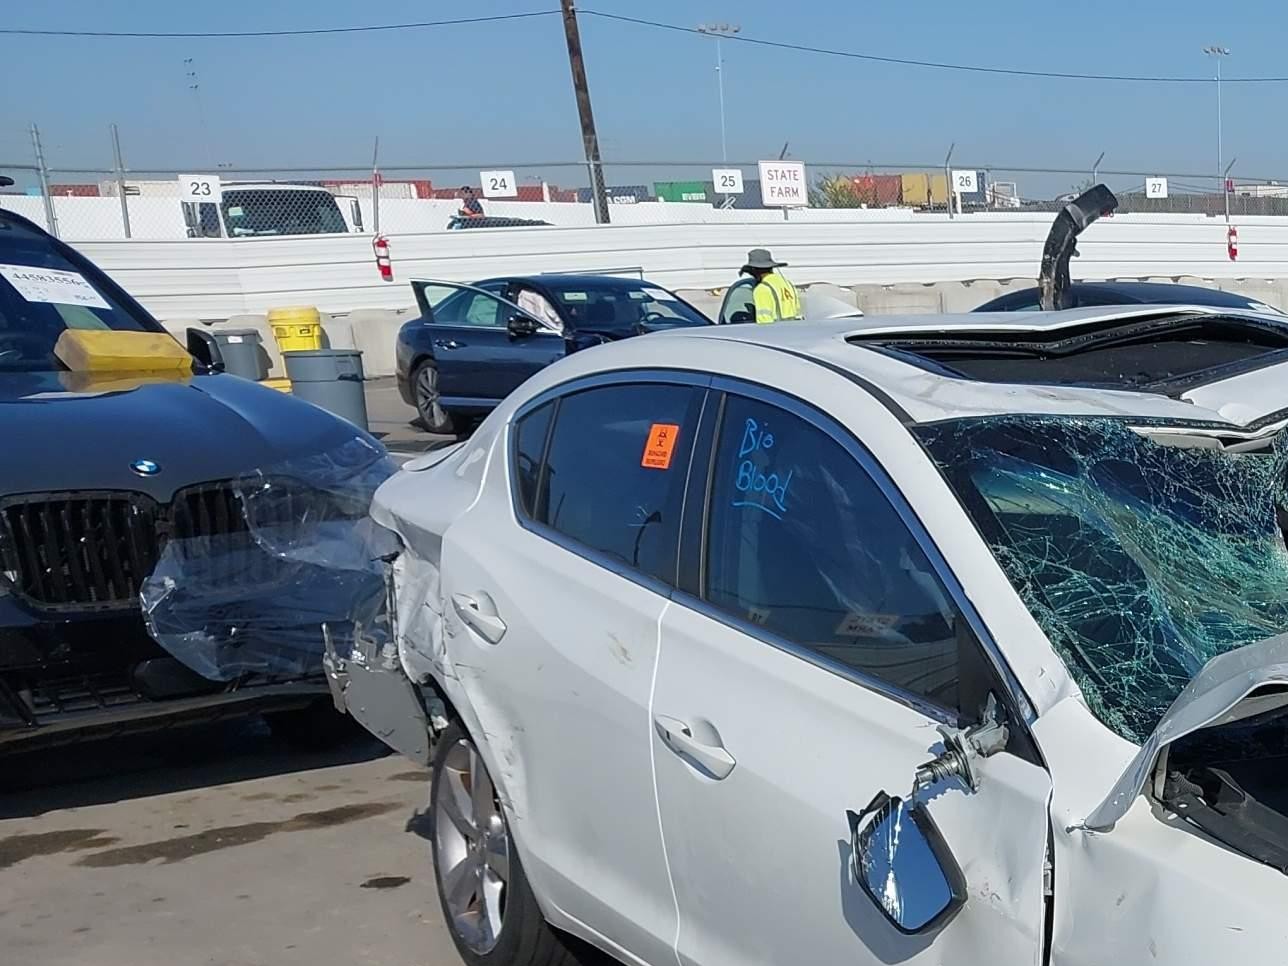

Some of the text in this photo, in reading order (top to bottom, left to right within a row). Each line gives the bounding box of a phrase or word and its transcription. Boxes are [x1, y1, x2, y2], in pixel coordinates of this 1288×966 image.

[720, 175, 736, 187] 25
[767, 169, 799, 181] STATE
[490, 178, 507, 190] 24
[959, 176, 971, 187] 26
[190, 181, 211, 196] 23
[770, 186, 799, 198] FARM
[1151, 183, 1162, 193] 27
[738, 418, 774, 458] Bio
[736, 460, 793, 512] Blood
